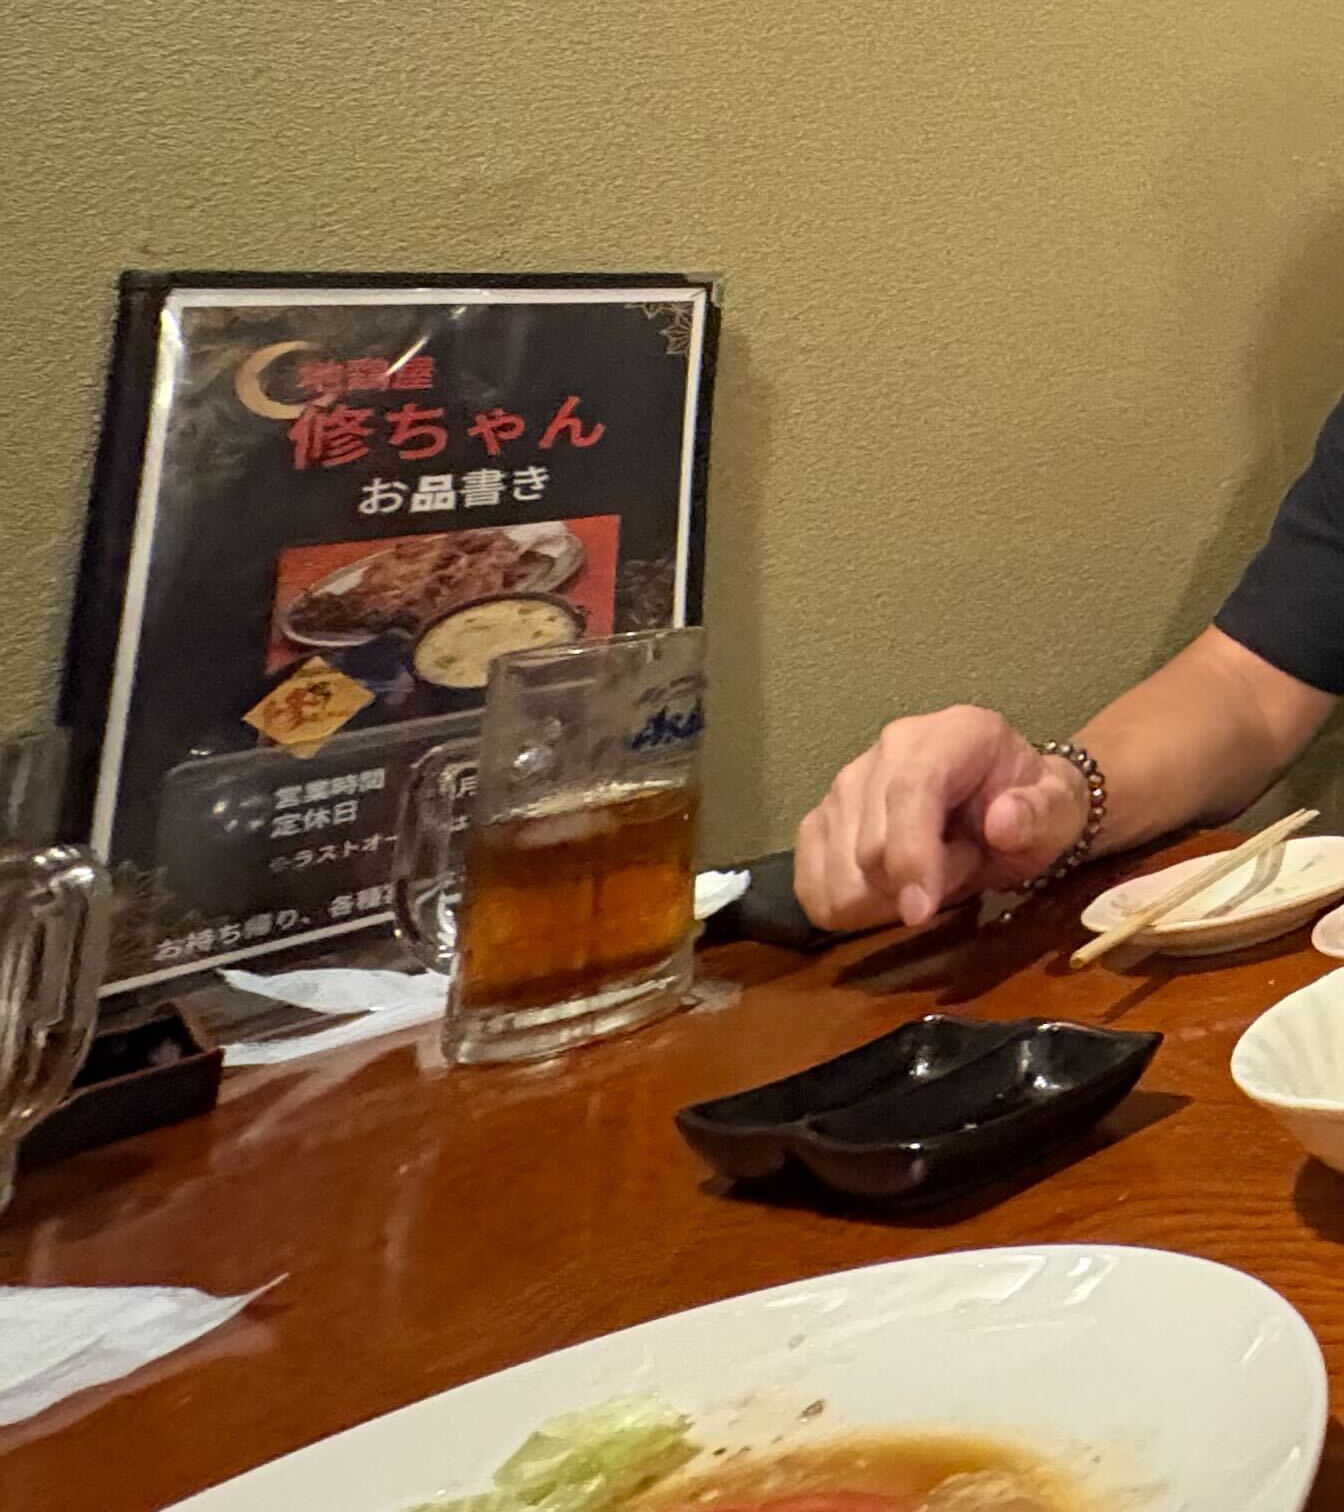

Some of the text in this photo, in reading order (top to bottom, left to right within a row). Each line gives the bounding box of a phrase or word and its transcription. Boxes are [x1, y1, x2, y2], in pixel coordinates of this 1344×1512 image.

[286, 394, 607, 470] 修ちゃん
[357, 464, 551, 516] お品書き
[273, 767, 387, 810] 営業時間
[269, 799, 360, 839] 定休日
